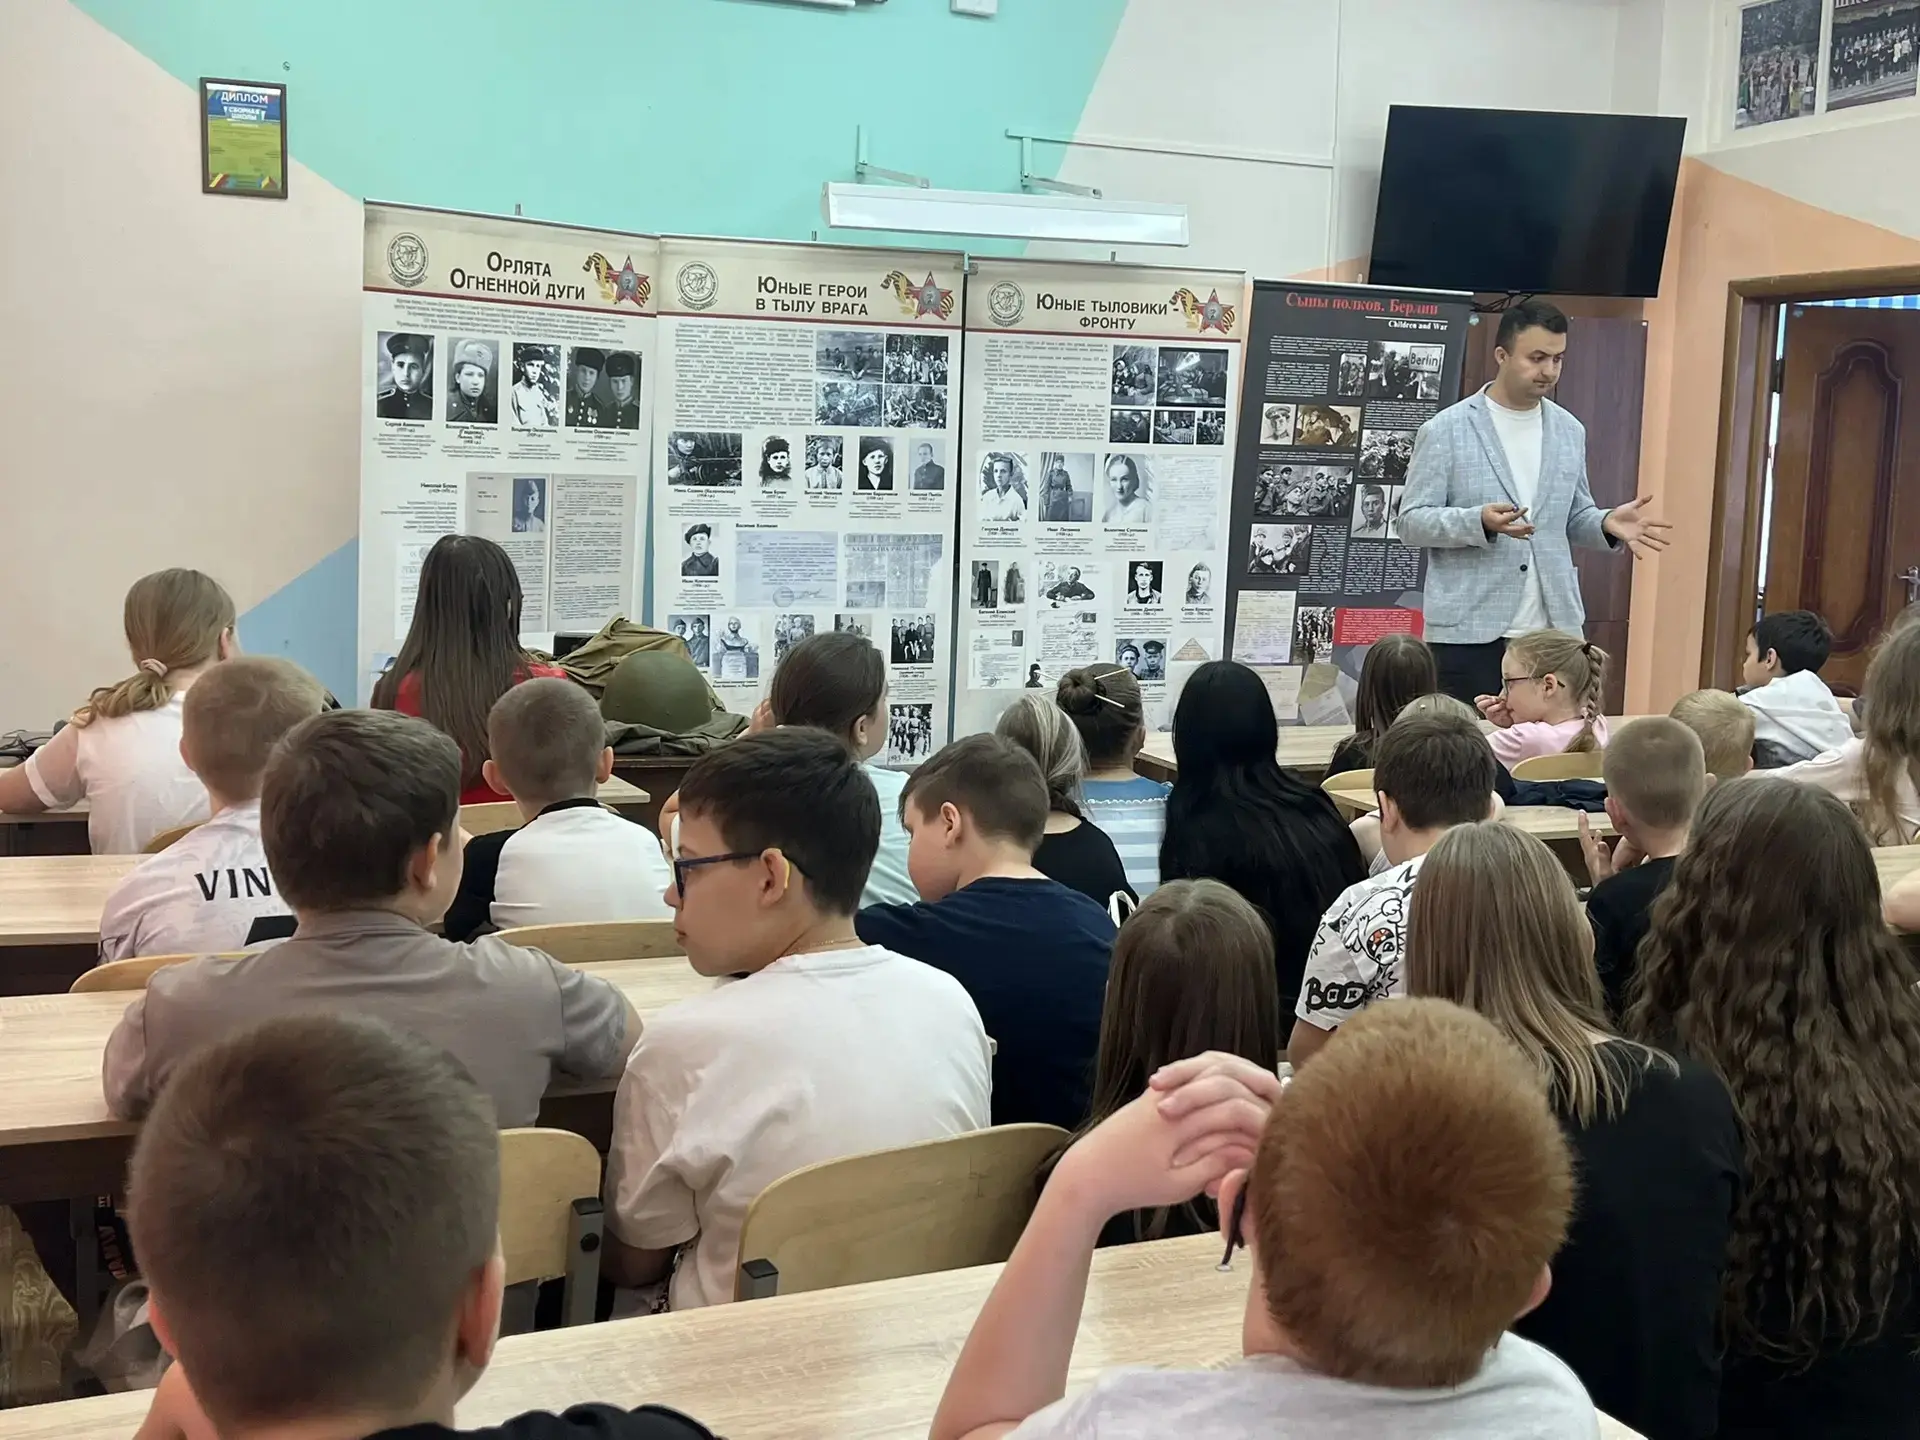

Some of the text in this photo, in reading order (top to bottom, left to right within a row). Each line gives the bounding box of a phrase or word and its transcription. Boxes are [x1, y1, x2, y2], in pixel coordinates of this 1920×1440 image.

[221, 92, 268, 104] ДИПЛОМ
[486, 251, 552, 277] ОРЛЯТА
[449, 268, 585, 300] ОГНЕННОЙ ДУГИ
[757, 276, 867, 299] ЮНЫЕ ГЕРОИ
[756, 298, 869, 316] В ТЫЛУ ВРАГА
[1036, 293, 1086, 312] ЮНЫЕ
[1091, 300, 1168, 316] ТЫЛОВИКИ
[1286, 292, 1329, 309] Сыны
[1389, 298, 1439, 316] Берлин
[1079, 316, 1137, 331] ФРОНТУ
[1388, 319, 1449, 331] Children and War
[1410, 352, 1439, 368] Berlin
[194, 867, 271, 901] VIN
